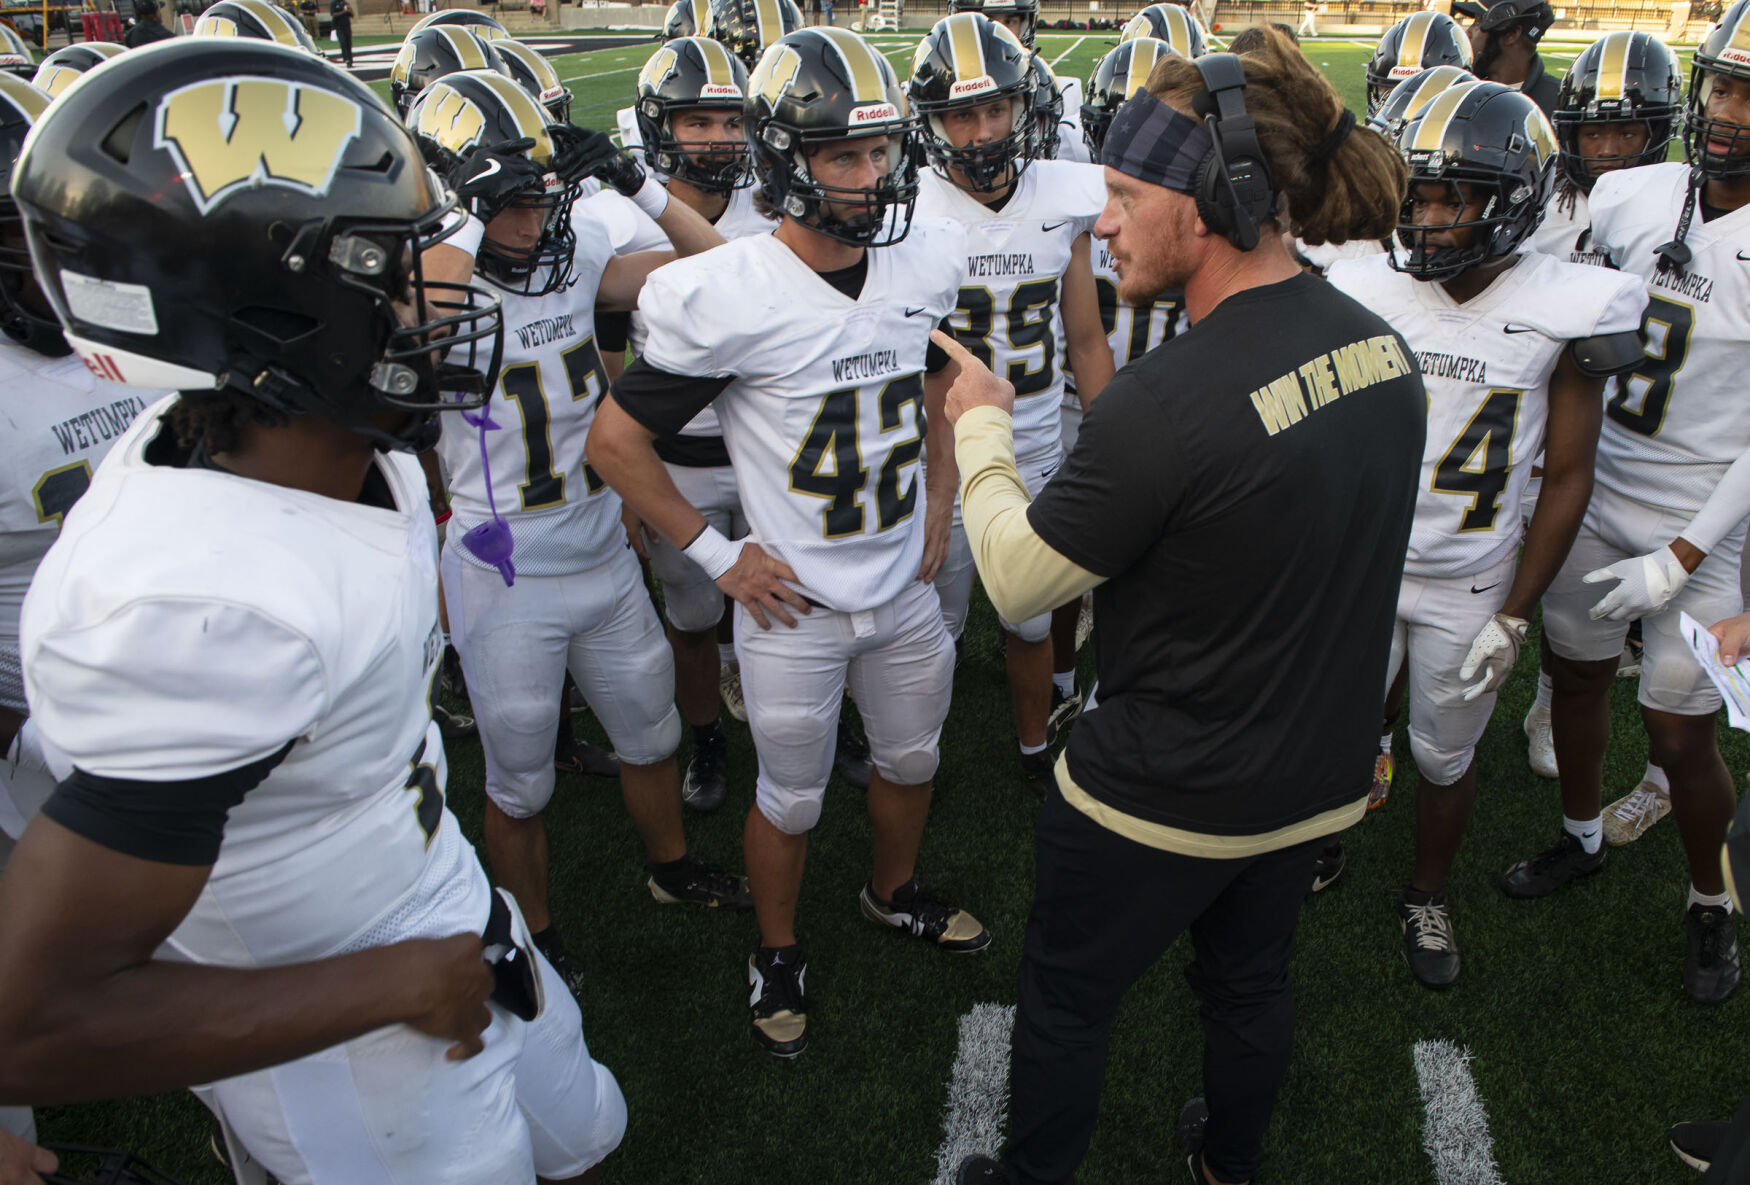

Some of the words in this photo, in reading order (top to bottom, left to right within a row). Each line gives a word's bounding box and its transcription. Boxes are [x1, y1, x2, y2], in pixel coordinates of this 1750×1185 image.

[856, 105, 895, 121] Riddell
[955, 79, 991, 94] Riddell
[967, 252, 1035, 277] WETUMPKA
[832, 349, 902, 383] WETUMPKA
[1606, 291, 1697, 439] 8
[1250, 370, 1309, 437] WIN
[1299, 353, 1340, 411] THE
[788, 370, 928, 540] 42
[1426, 386, 1524, 534] 4
